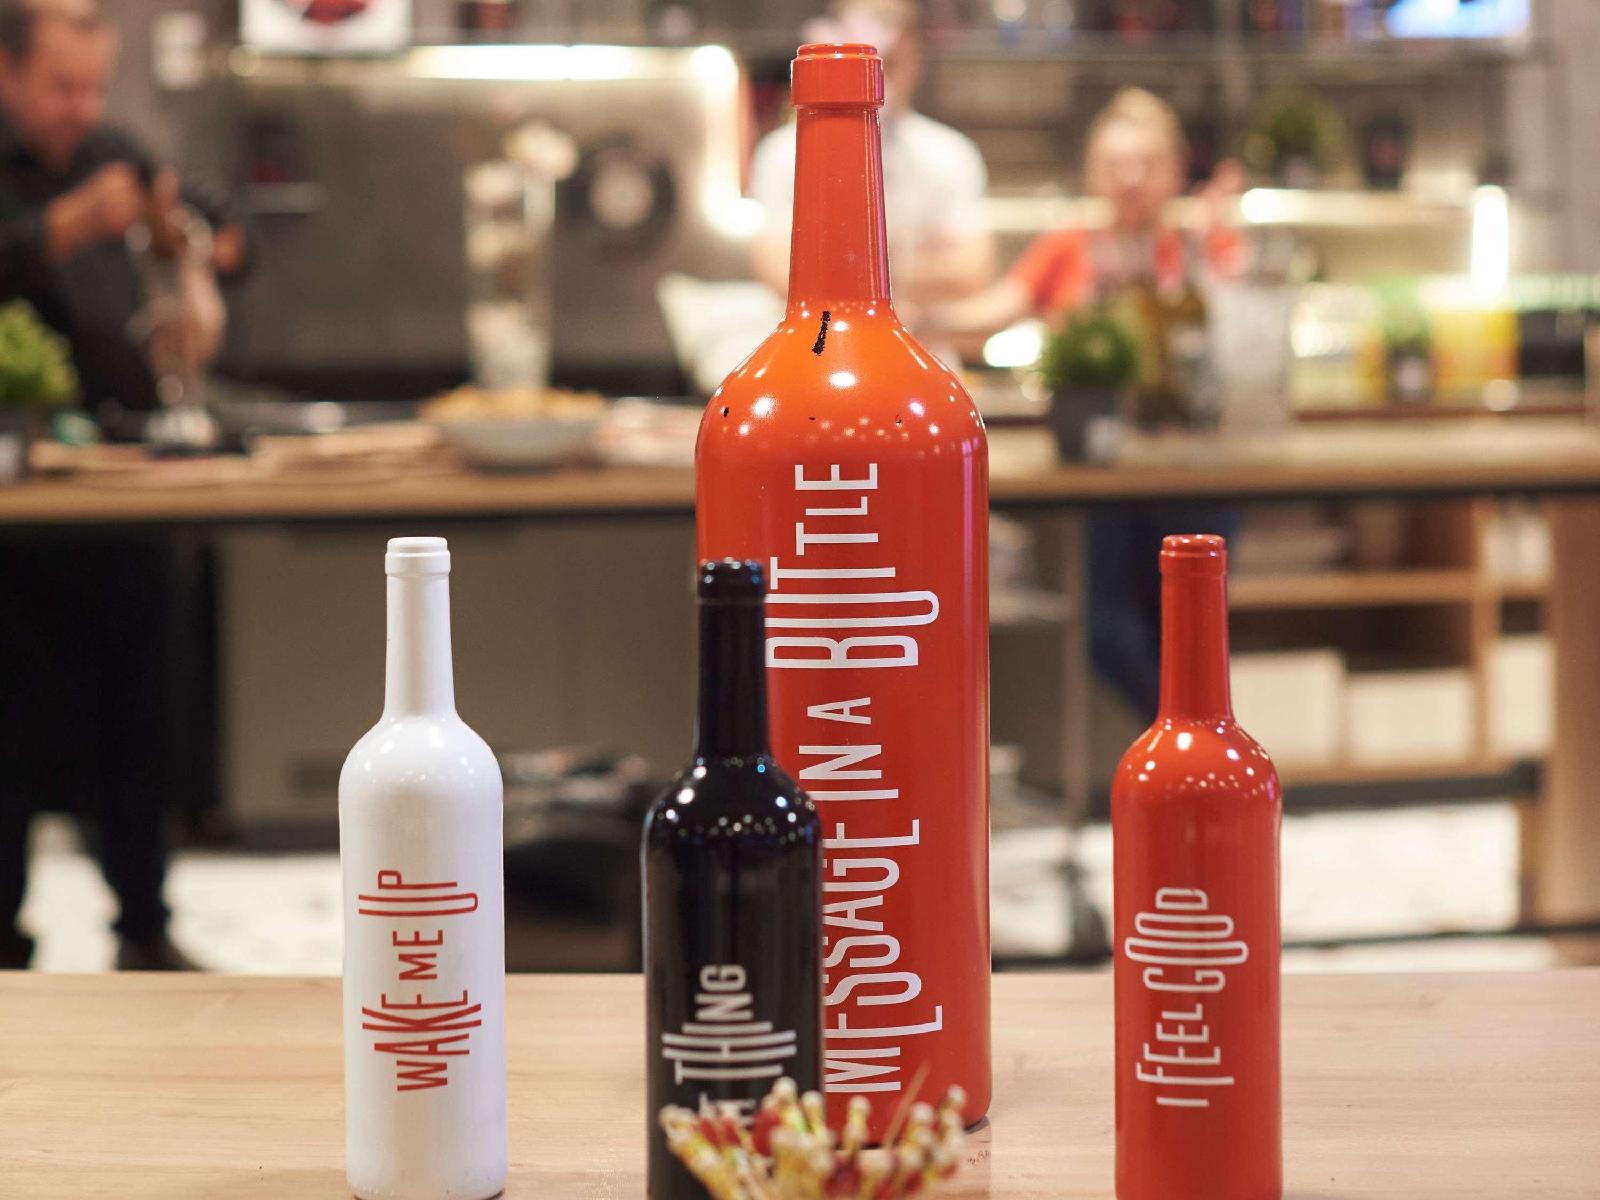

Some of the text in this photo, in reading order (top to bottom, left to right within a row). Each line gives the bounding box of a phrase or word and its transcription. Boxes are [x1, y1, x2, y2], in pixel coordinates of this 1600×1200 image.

[764, 463, 943, 1093] MESSAGE IN A BOTTLE
[358, 869, 482, 1092] WAKE ME UP
[661, 964, 797, 1086] THING
[1124, 887, 1249, 1108] I FEEL GOOD
